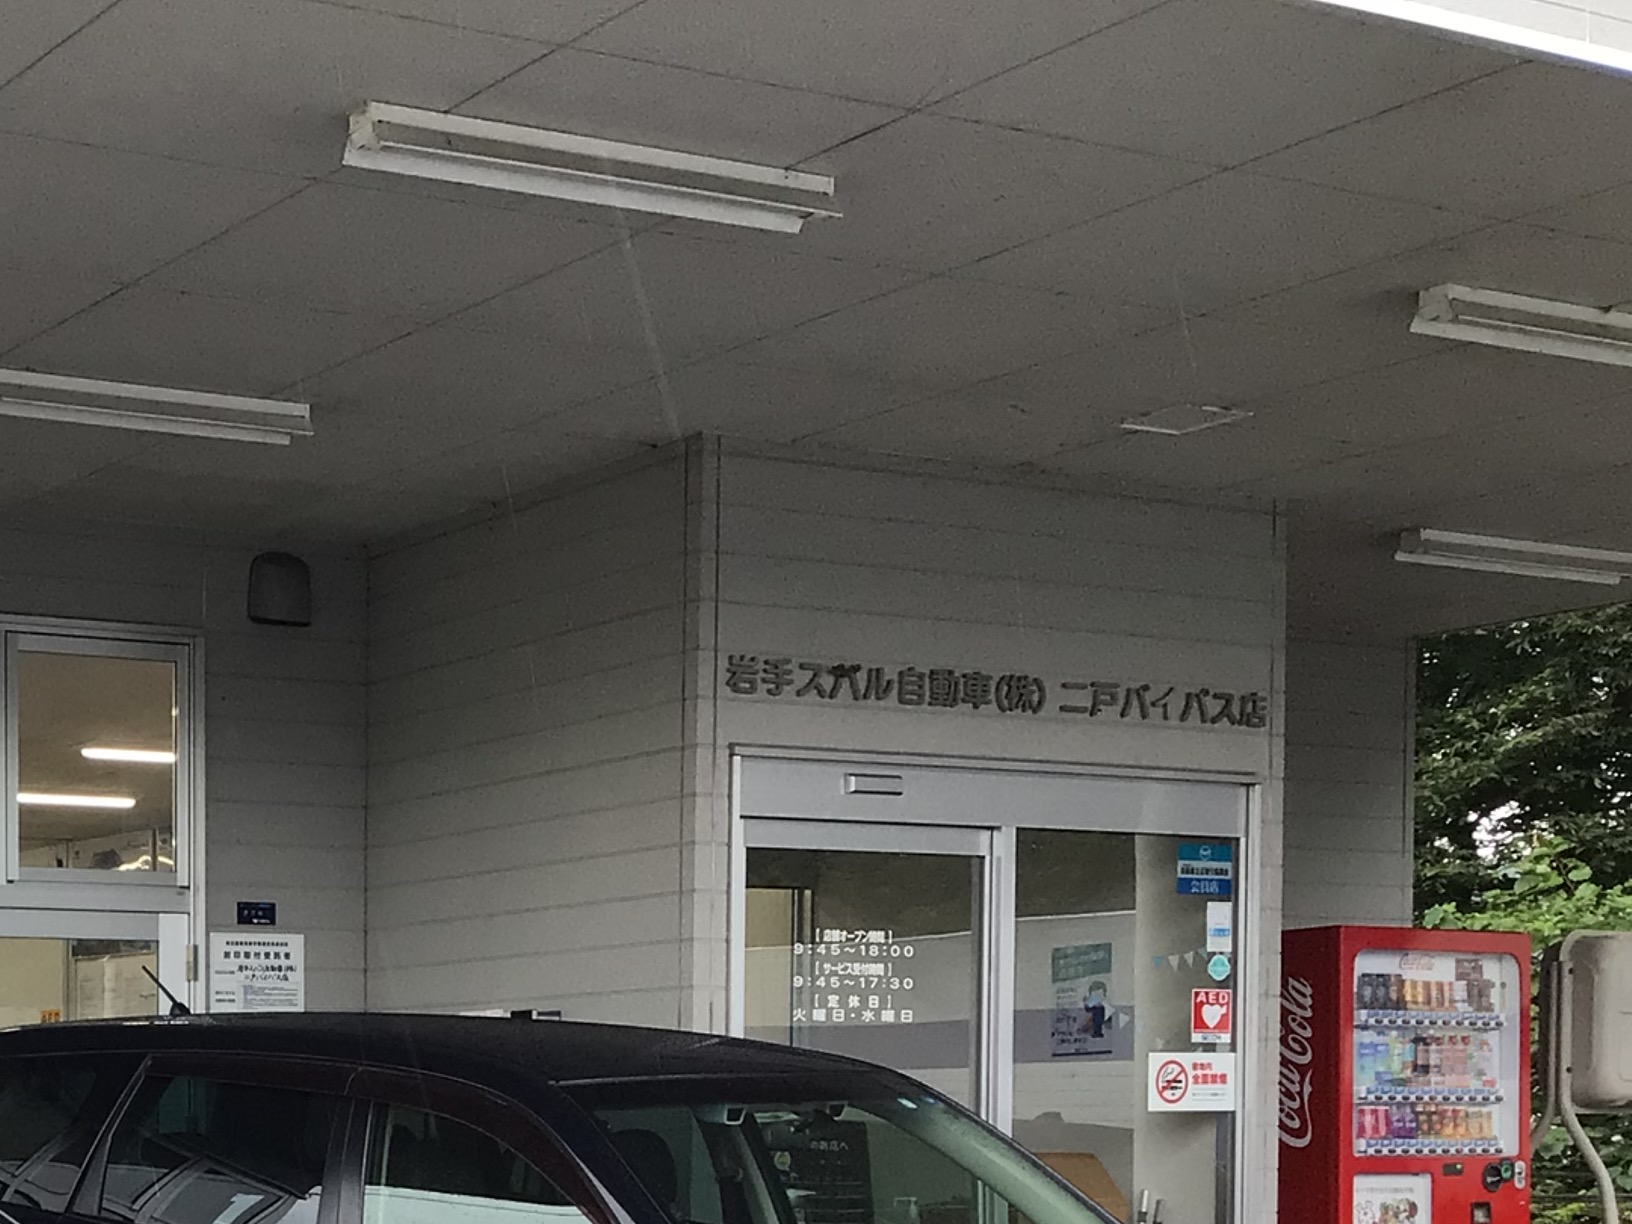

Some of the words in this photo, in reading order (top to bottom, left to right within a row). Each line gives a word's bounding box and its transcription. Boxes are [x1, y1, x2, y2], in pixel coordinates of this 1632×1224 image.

[1059, 681, 1268, 728] 二戸バイパス店
[1196, 991, 1229, 1004] AED
